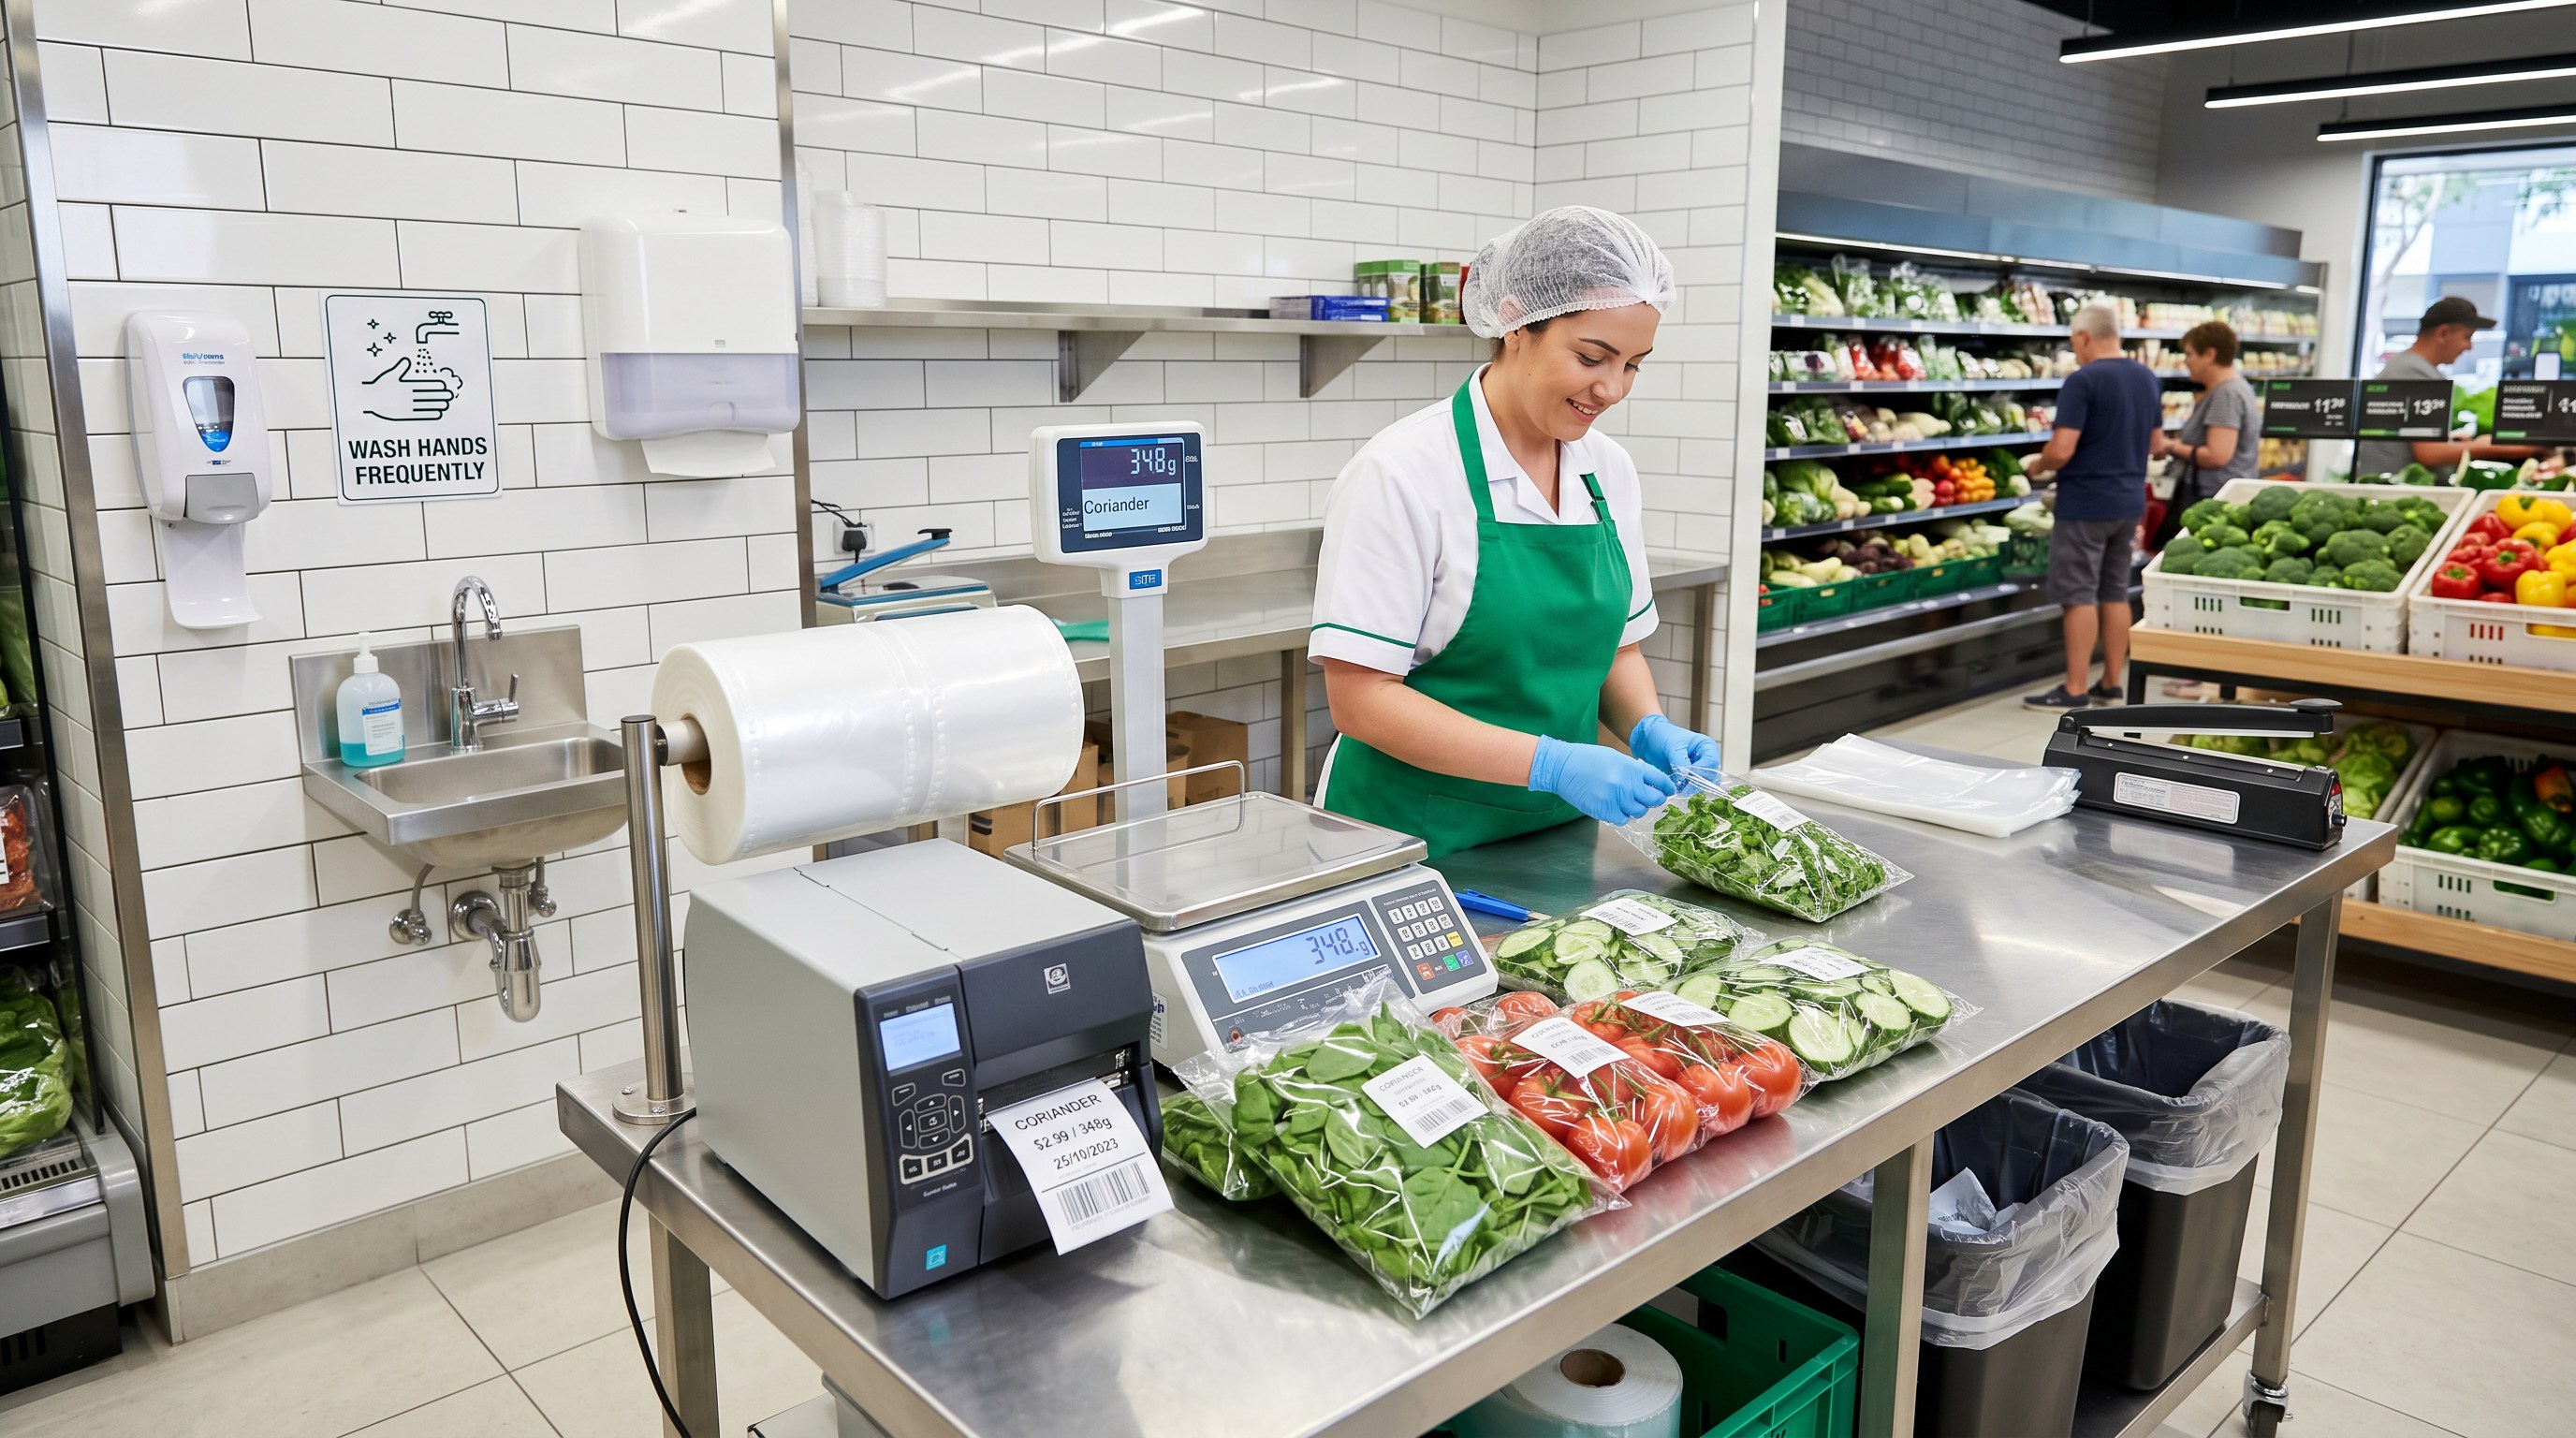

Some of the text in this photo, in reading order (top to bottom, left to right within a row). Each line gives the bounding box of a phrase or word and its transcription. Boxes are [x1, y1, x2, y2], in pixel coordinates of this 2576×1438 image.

[348, 436, 488, 460] WASH HANDS
[355, 462, 485, 485] FREQUENTLY
[1084, 496, 1149, 515] Coriander
[1015, 1093, 1103, 1131] CORIANDER
[1033, 1117, 1113, 1151] $2.99 / 348g
[1053, 1137, 1119, 1170] 25/10/2023
